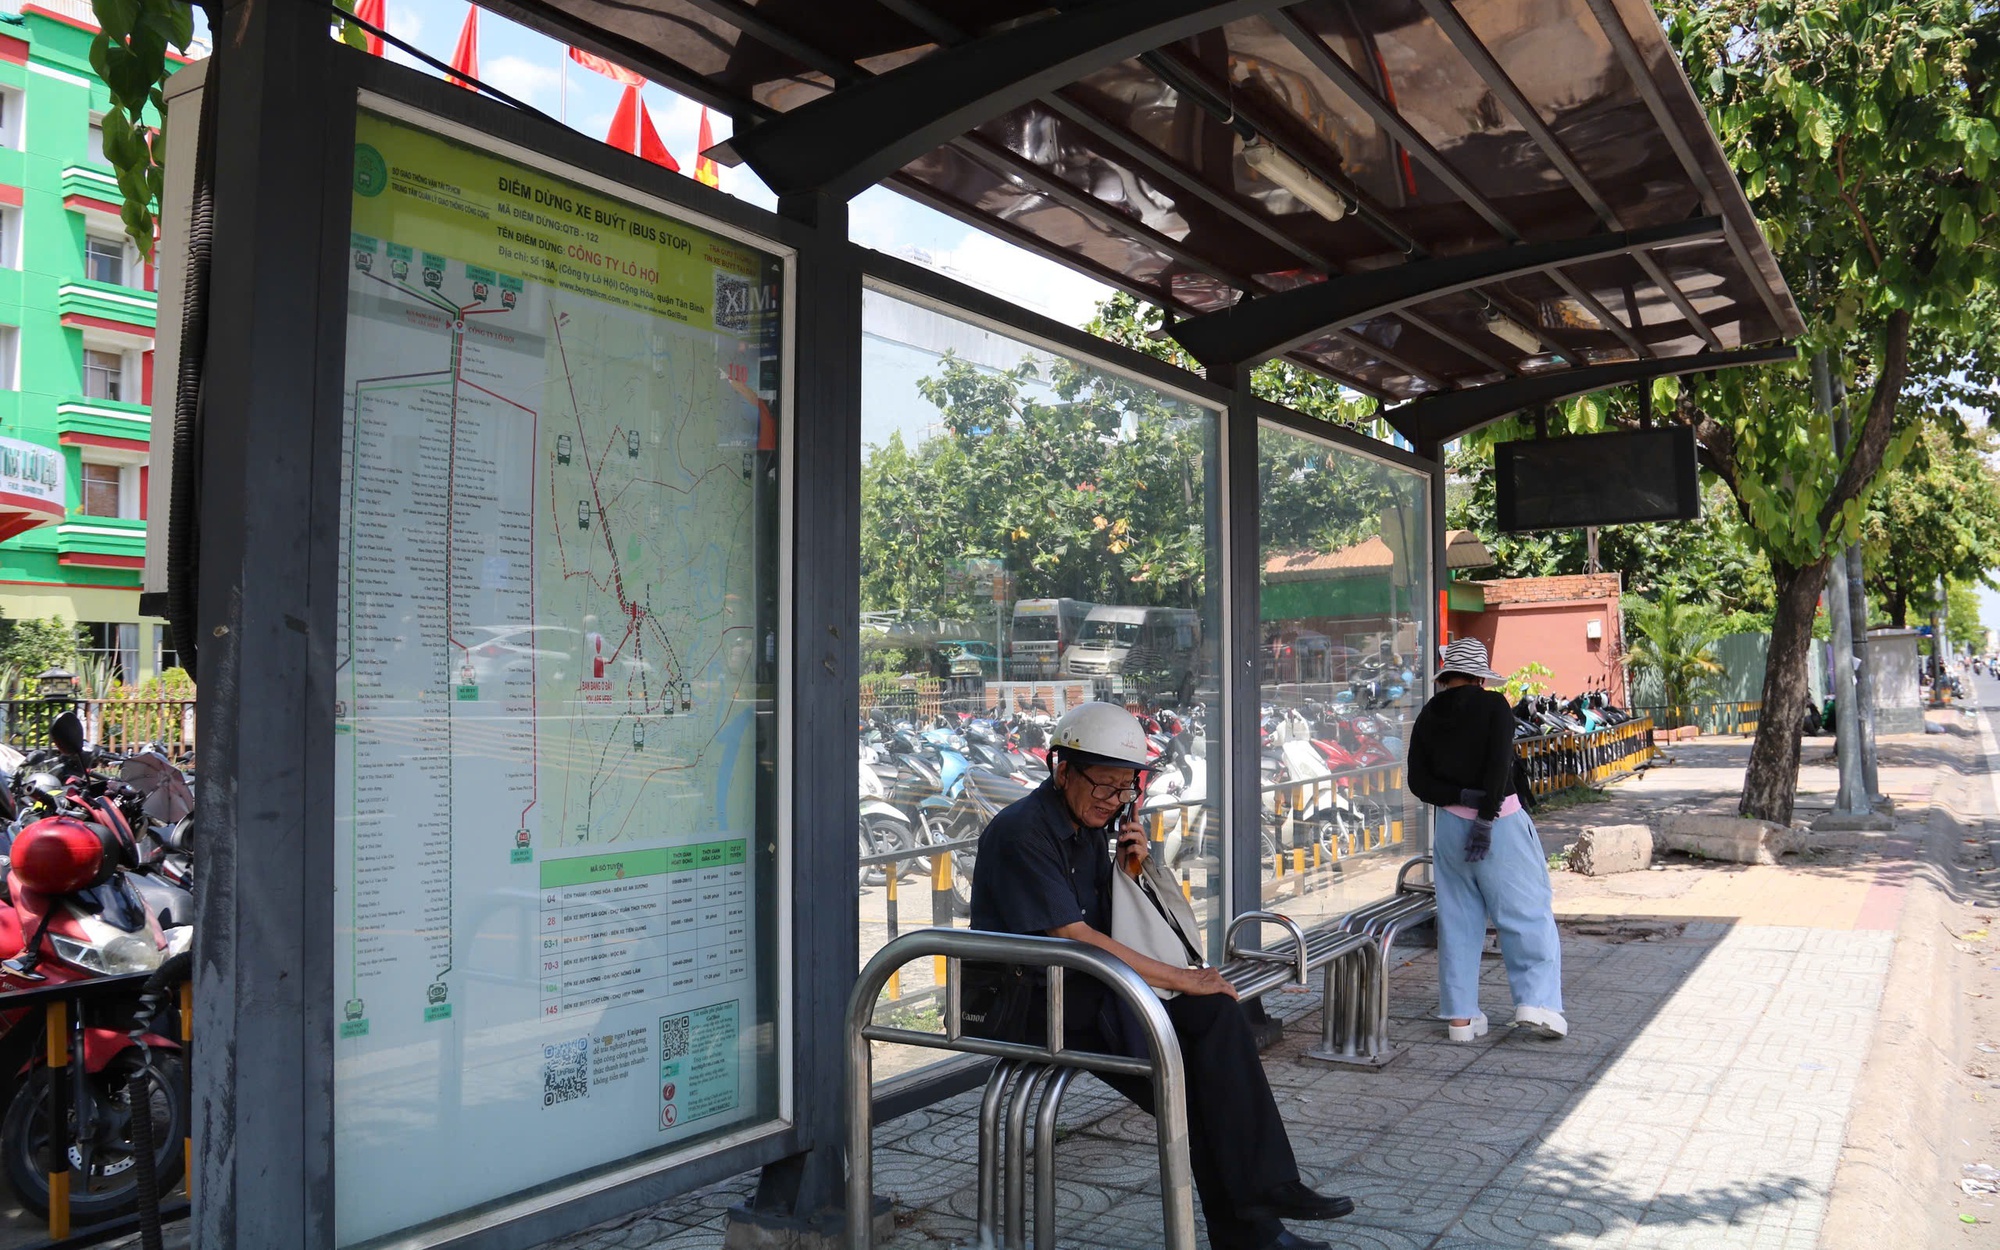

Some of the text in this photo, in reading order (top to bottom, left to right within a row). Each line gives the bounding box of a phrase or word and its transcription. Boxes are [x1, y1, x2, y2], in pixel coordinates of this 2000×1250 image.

[498, 176, 692, 256] ĐIỂM DỪNG XE BUÝT (BUS STOP)
[498, 202, 510, 215] MÃ
[586, 232, 599, 244] 122
[498, 226, 514, 240] TÊN
[568, 244, 602, 266] CÔNG
[605, 256, 619, 271] TY
[622, 261, 636, 276] LÔ
[640, 267, 659, 284] HỘI
[498, 245, 512, 258] Địa
[558, 264, 582, 280] (Công
[584, 270, 590, 283] ty
[604, 276, 618, 290] Hội)
[620, 282, 638, 296] Cộng
[657, 294, 674, 306] quận
[676, 298, 688, 310] Tân
[546, 894, 556, 904] 04
[547, 916, 556, 926] 28
[544, 939, 558, 949] 63-1
[544, 960, 559, 971] 70-3
[545, 1005, 558, 1016] 145
[962, 1010, 985, 1022] Canon
